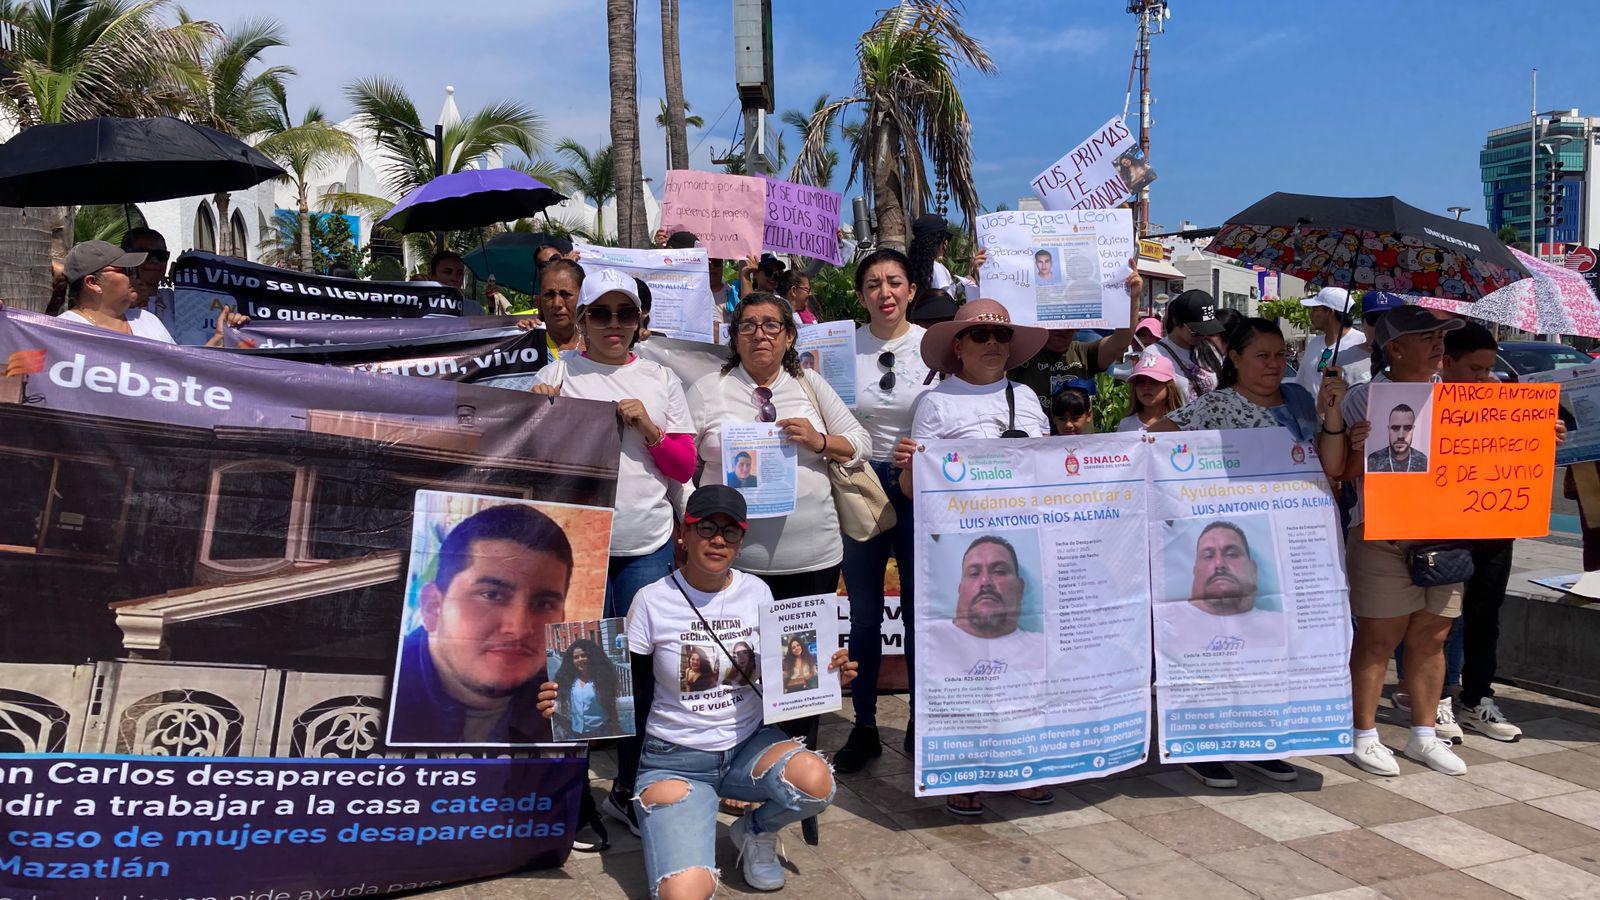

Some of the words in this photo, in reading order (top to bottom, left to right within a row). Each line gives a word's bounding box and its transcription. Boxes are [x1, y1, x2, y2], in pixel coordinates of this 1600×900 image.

[1033, 165, 1067, 196] TUS
[1071, 121, 1129, 173] PRIMAS
[665, 176, 681, 195] Hoy
[683, 178, 714, 191] marcho
[717, 182, 733, 193] por
[1060, 173, 1092, 200] TE
[664, 201, 672, 215] Te
[676, 207, 710, 218] queremos
[711, 206, 720, 218] de
[779, 185, 791, 202] SE
[797, 188, 838, 215] CUMPLEN
[782, 204, 812, 228] DÍAS
[817, 214, 835, 238] SIN
[982, 213, 1015, 230] José
[1019, 212, 1071, 228] Israel
[1078, 210, 1118, 224] León
[719, 231, 739, 241] viva
[1097, 235, 1130, 246] Quiero
[800, 232, 840, 262] CRISTINA
[1102, 261, 1121, 269] con
[204, 267, 260, 289] Vivo
[266, 279, 294, 293] se
[298, 283, 321, 296] lo
[325, 286, 423, 309] llevaron,
[428, 294, 463, 311] vivo
[248, 301, 271, 318] lo
[473, 347, 539, 369] vivo
[50, 353, 233, 410] debate
[1438, 384, 1493, 402] MARCO
[1499, 385, 1557, 401] ANTONIO
[1440, 408, 1507, 427] AGUIRRE
[1511, 408, 1556, 423] GARCIA
[1440, 437, 1540, 455] DESAPARECIO
[1083, 454, 1130, 465] SINALOA
[1198, 456, 1241, 470] Sinaloa
[970, 466, 1013, 481] Sinaloa
[1435, 465, 1448, 488] 8
[1456, 465, 1478, 483] DE
[1485, 464, 1544, 482] JUNIO
[946, 494, 1025, 513] Ayúdanos
[1031, 494, 1039, 506] a
[1043, 488, 1121, 506] encontrar
[1123, 491, 1133, 501] a
[1180, 484, 1255, 502] Ayúdanos
[1260, 483, 1268, 493] a
[1463, 487, 1530, 513] 2025
[1191, 503, 1214, 516] LUIS
[1218, 501, 1270, 514] ANTONIO
[1272, 496, 1299, 510] RÍOS
[959, 517, 984, 529] LUIS
[988, 514, 1040, 528] ANTONIO
[1043, 511, 1070, 524] RÍOS
[1074, 506, 1121, 522] ALEMÁN
[712, 619, 742, 631] FALTAN
[778, 610, 817, 622] NUESTRA
[783, 622, 814, 633] CHINA?
[681, 693, 700, 701] LAS
[692, 704, 705, 712] DE
[1170, 712, 1180, 721] Si
[1184, 711, 1215, 720] tienes
[1219, 708, 1279, 719] información
[1170, 723, 1197, 732] llama
[1270, 719, 1282, 728] Tu
[1325, 714, 1345, 724] muy
[928, 740, 938, 750] Si
[943, 740, 974, 750] tienes
[979, 734, 1037, 747] información
[1040, 727, 1081, 740] referente
[1084, 727, 1090, 735] a
[1196, 741, 1219, 752] (669)
[1220, 740, 1237, 749] 327
[1239, 740, 1261, 749] 8424
[928, 753, 955, 763] llama
[1027, 745, 1039, 754] Tu
[1070, 740, 1080, 748] es
[1082, 737, 1103, 747] muy
[48, 762, 175, 786] Carlos
[187, 764, 406, 791] desapareció
[416, 766, 477, 786] tras
[954, 770, 978, 782] (669)
[979, 770, 996, 779] 327
[998, 768, 1019, 779] 8424
[74, 799, 96, 816] a
[110, 794, 265, 821] trabajar
[274, 799, 294, 816] a
[307, 795, 335, 815] la
[347, 799, 420, 815] casa
[431, 792, 553, 815] cateada
[8, 830, 102, 848] caso
[113, 825, 163, 848] de
[176, 823, 327, 851] mujeres
[337, 819, 566, 845] desaparecidas
[0, 855, 170, 879] Mazatlán
